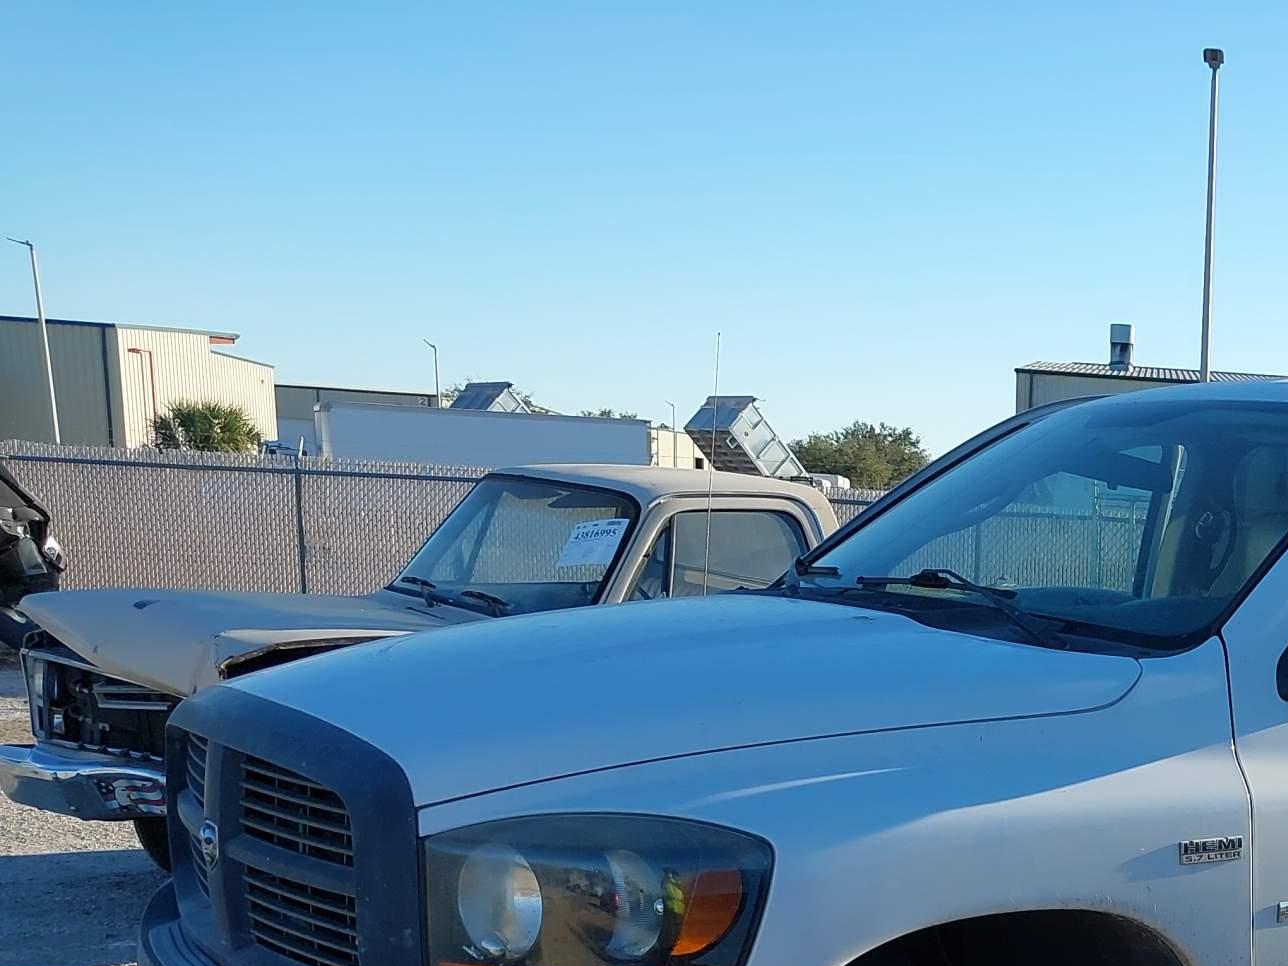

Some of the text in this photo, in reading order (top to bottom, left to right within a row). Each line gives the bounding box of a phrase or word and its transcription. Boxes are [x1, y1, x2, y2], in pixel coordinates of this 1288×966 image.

[1181, 836, 1243, 855] HEMI
[1184, 850, 1241, 863] 5.7 LITER
